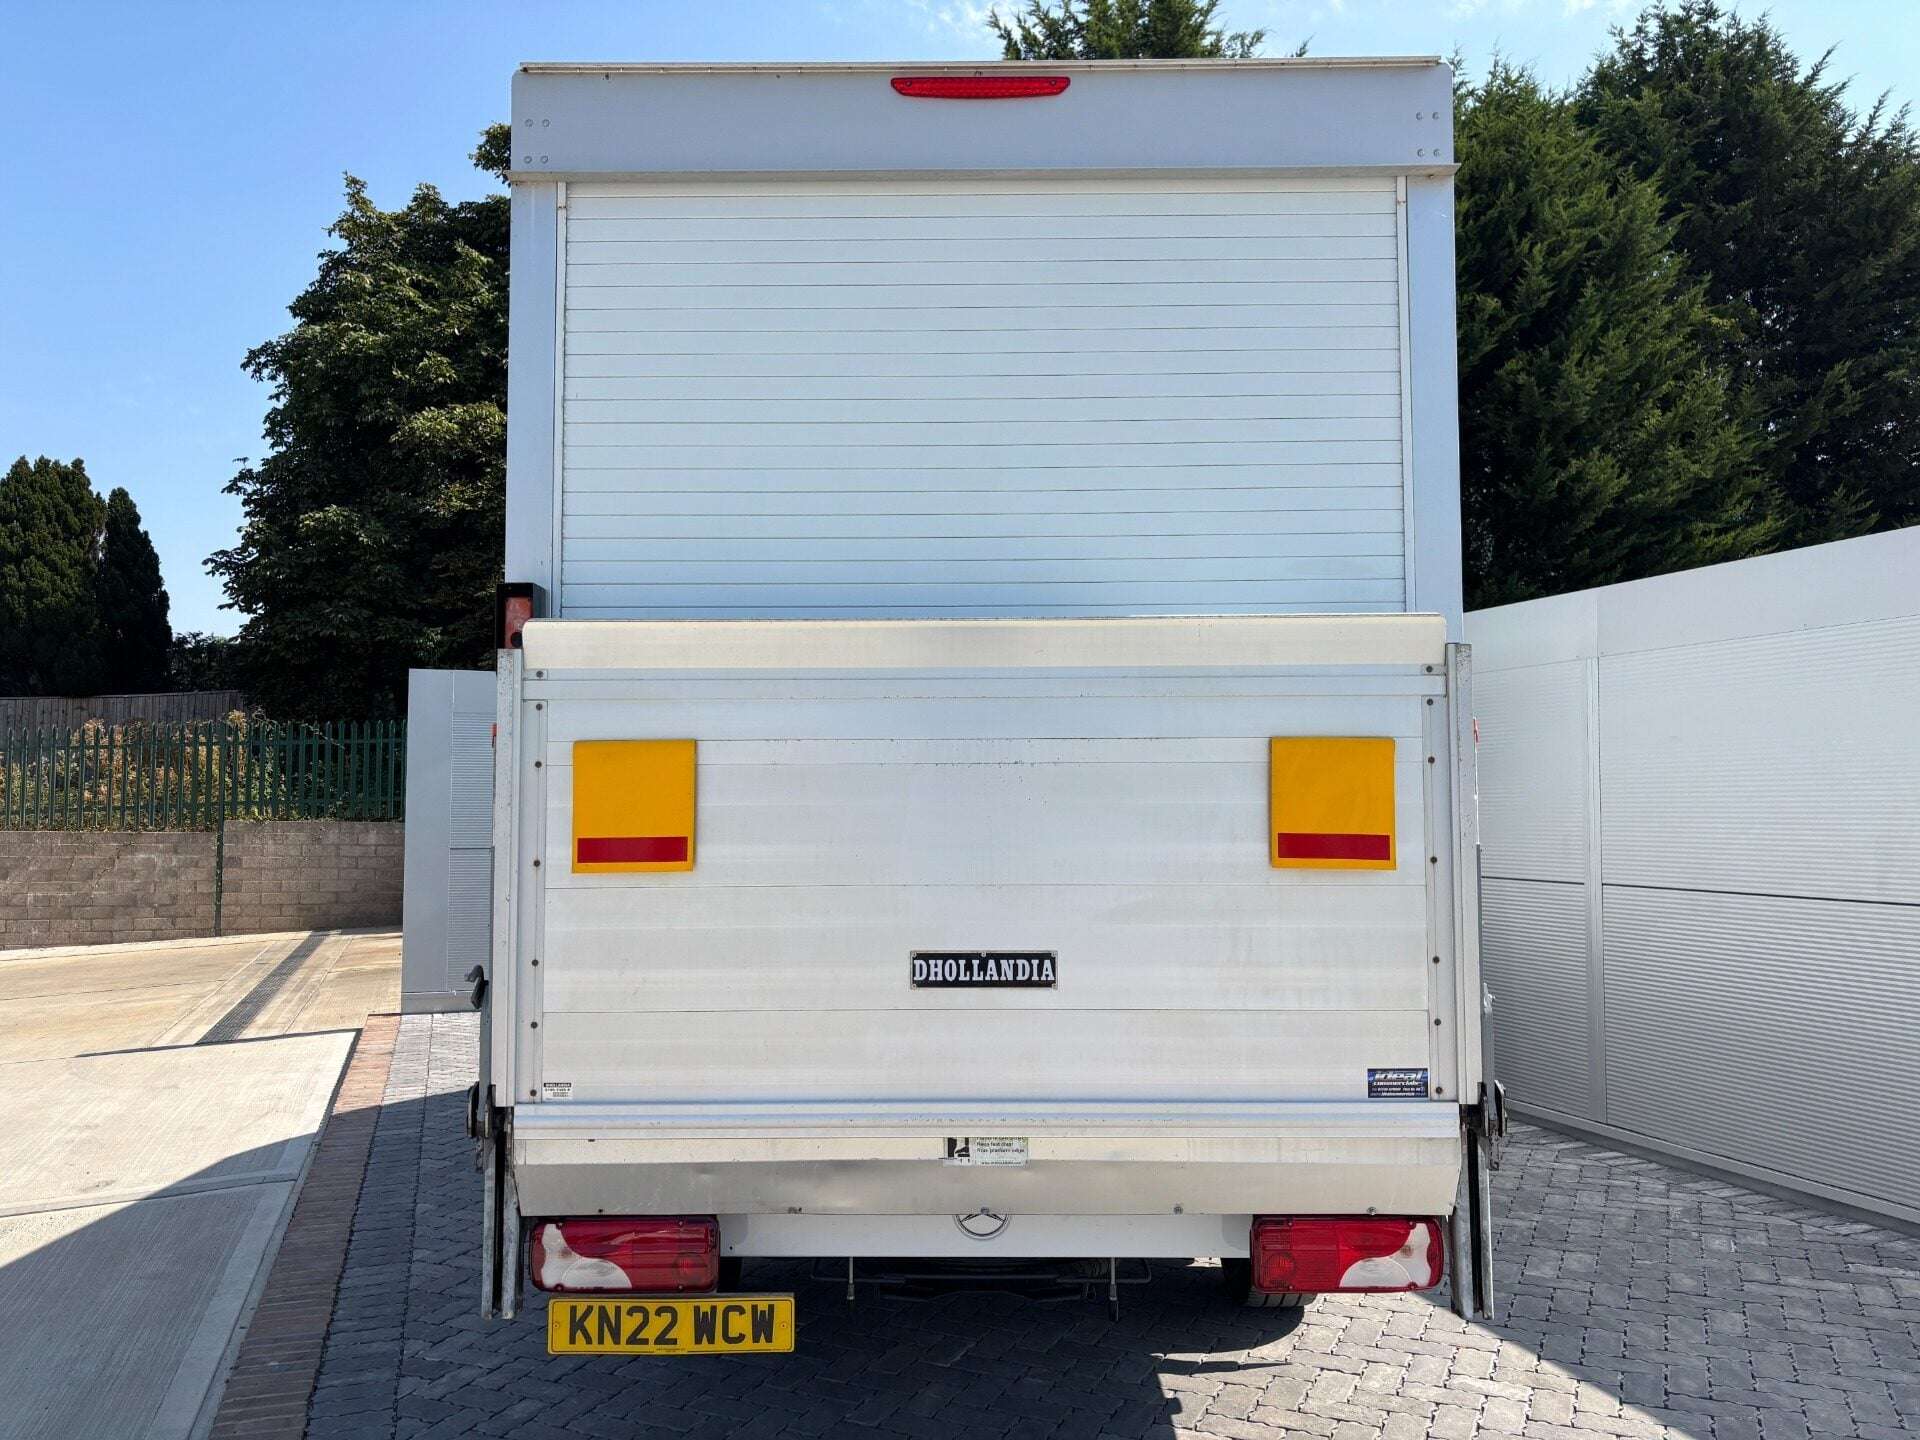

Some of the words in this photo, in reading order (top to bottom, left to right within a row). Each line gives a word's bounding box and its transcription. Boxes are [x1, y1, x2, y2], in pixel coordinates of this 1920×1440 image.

[913, 959, 1055, 982] DHOLLANDIA
[568, 1304, 679, 1345] KN22
[693, 1303, 776, 1345] WCW
